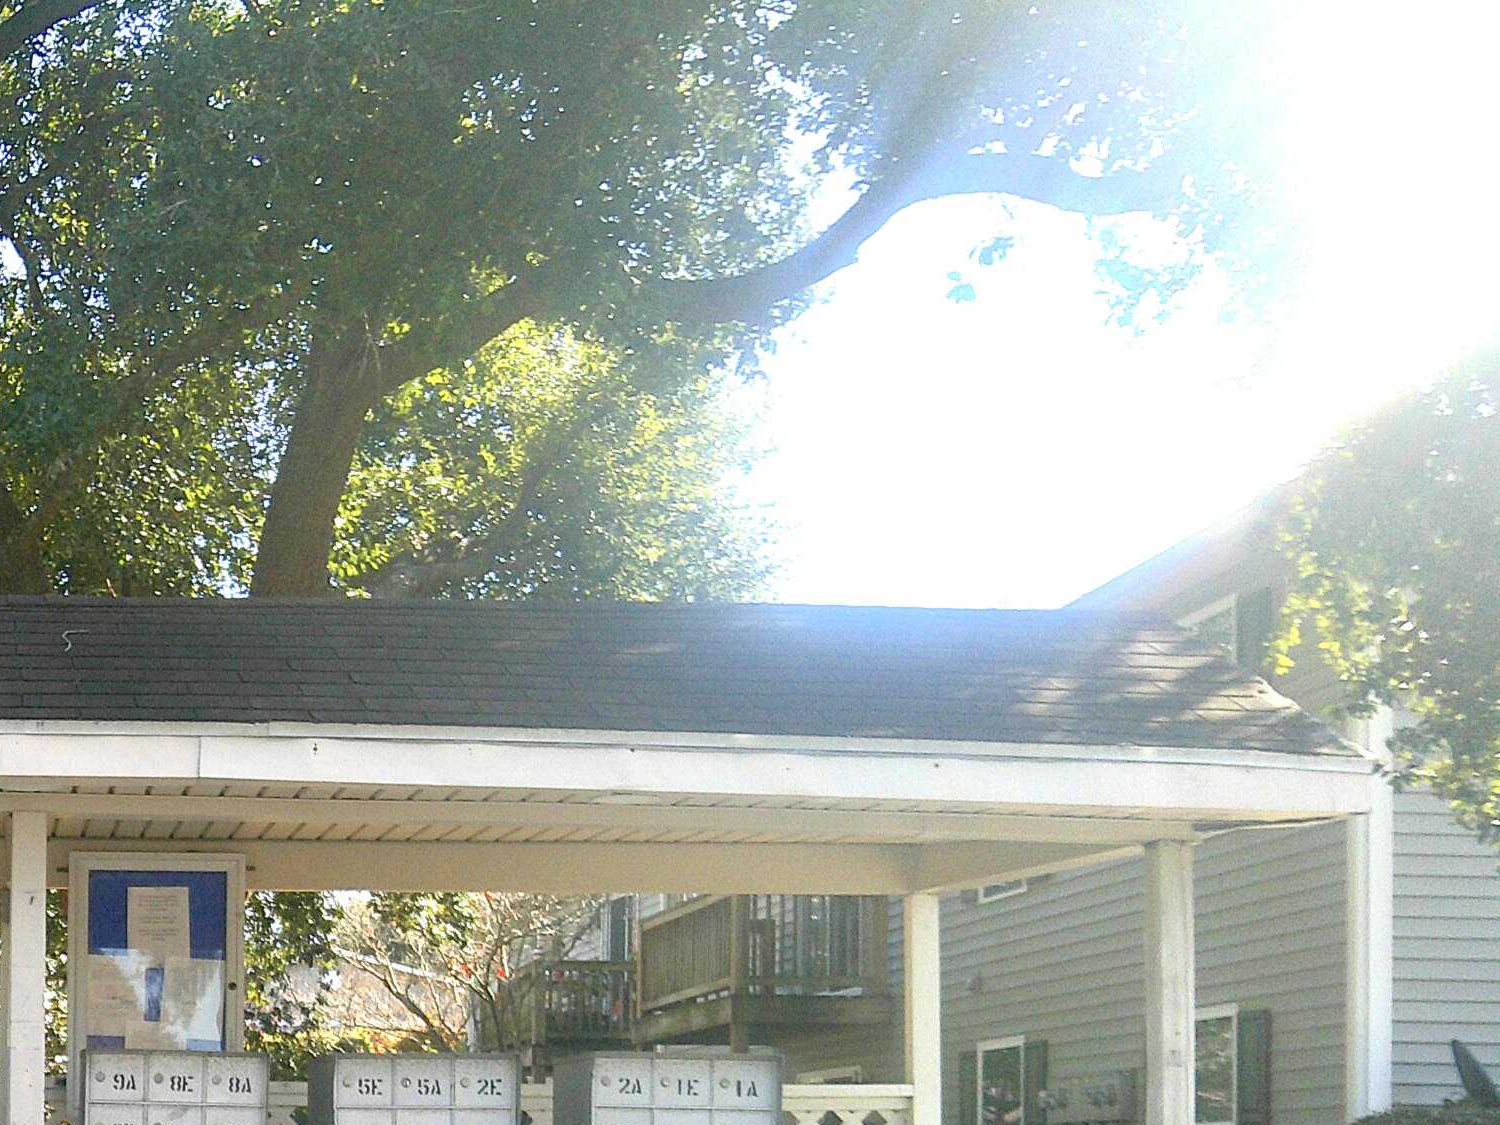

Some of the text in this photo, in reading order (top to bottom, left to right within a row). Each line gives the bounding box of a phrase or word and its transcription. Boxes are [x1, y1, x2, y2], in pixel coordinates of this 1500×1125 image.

[114, 1074, 136, 1090] 9A
[171, 1076, 193, 1092] 8E
[229, 1077, 251, 1093] 8A
[359, 1079, 382, 1095] 5E
[418, 1079, 441, 1095] 5A
[478, 1079, 502, 1095] 2E
[619, 1078, 641, 1094] 2A
[678, 1079, 699, 1096] 1E
[737, 1080, 758, 1097] 1A
